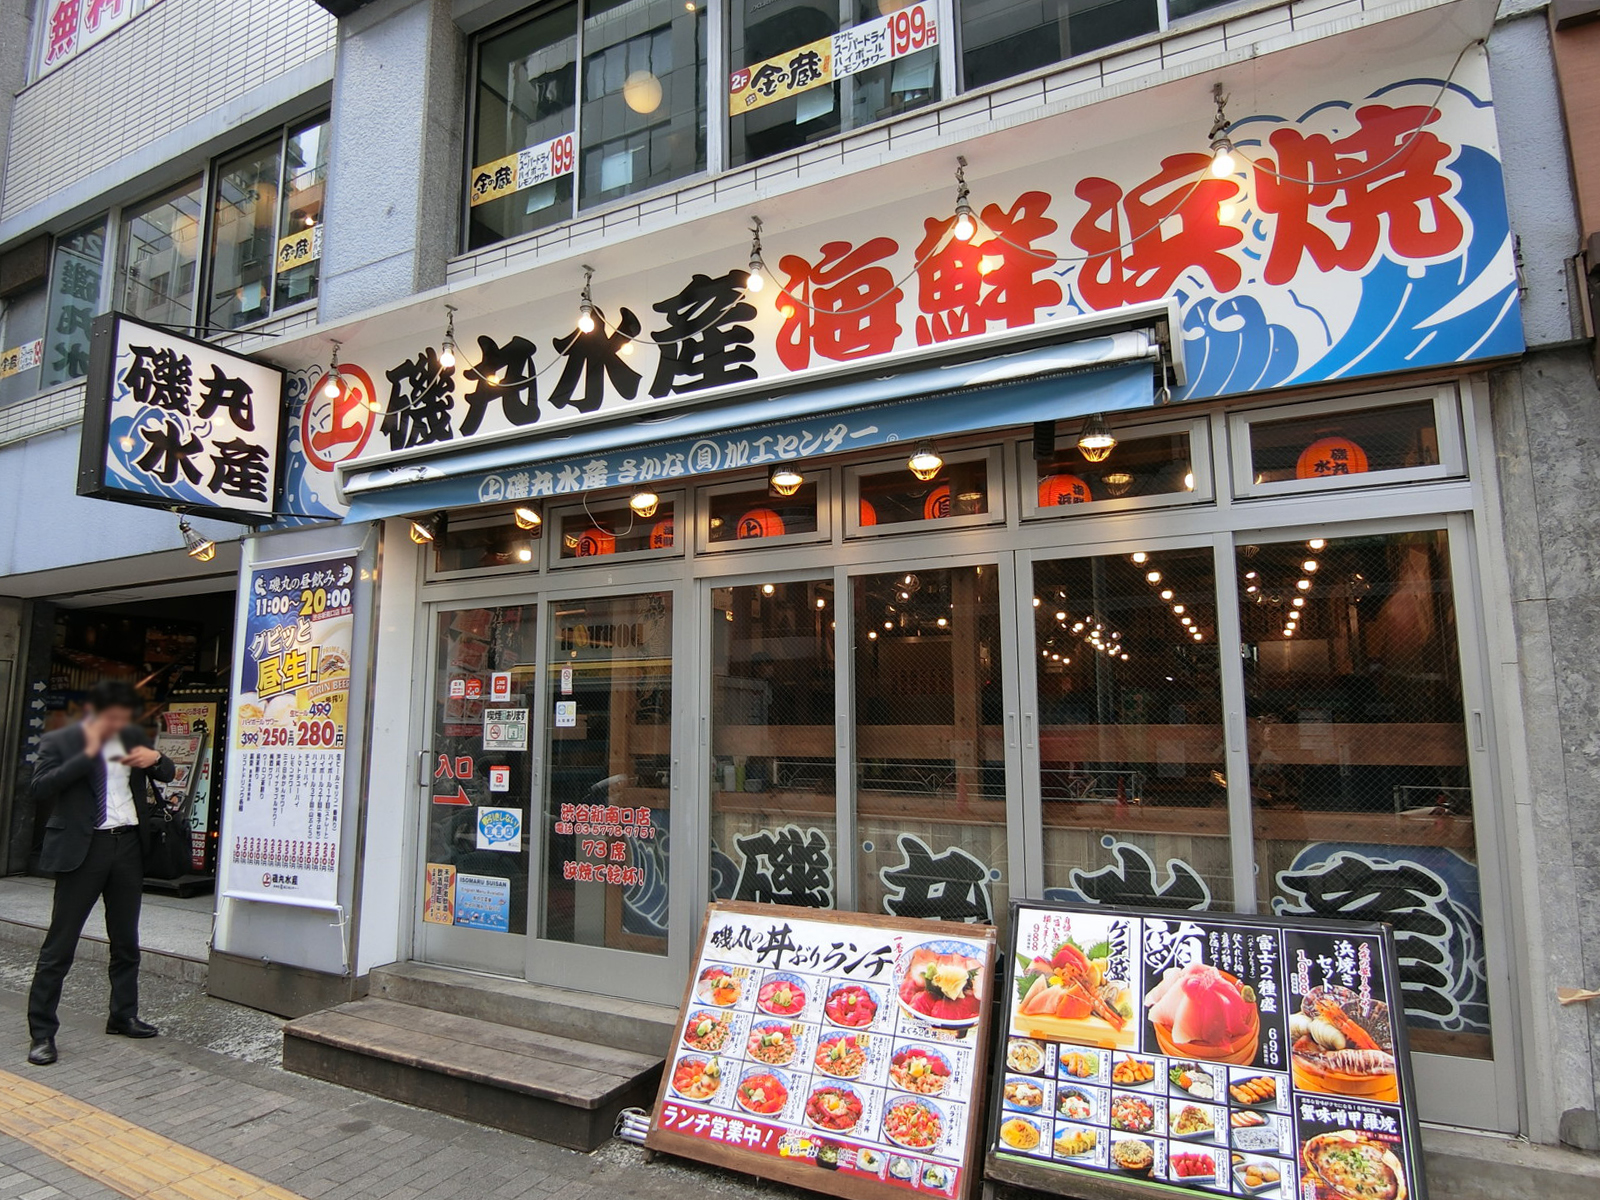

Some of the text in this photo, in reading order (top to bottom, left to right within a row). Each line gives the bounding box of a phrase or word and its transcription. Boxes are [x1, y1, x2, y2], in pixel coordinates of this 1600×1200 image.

[834, 31, 854, 45] アサヒ
[834, 27, 888, 56] スーパードライ
[887, 5, 937, 57] 199 円
[834, 41, 884, 67] ハイボール
[834, 54, 887, 77] レモンサワー
[731, 74, 748, 91] 2F
[751, 50, 822, 97] 金の蔵
[519, 151, 551, 170] スーパードライ
[550, 135, 573, 177] 199
[474, 165, 512, 194] 金の蔵
[518, 163, 548, 179] ハイボール
[518, 173, 549, 189] レモンサワー
[382, 104, 1464, 450] 磯丸水産 海鮮浜焼
[123, 344, 255, 432] 磯丸
[135, 419, 269, 502] 水産
[506, 459, 608, 499] 磯丸水産
[268, 570, 335, 593] 磯丸の昼飲み
[248, 616, 312, 660] グビッと
[262, 727, 288, 746] 250
[296, 720, 335, 746] 280
[435, 754, 473, 779] 入口
[561, 803, 651, 826] 渋谷新南口店
[582, 839, 607, 857] 73
[460, 877, 484, 885] ISOMARU
[563, 861, 644, 886] 浜焼で乾杯!
[711, 923, 894, 978] 磯丸の丼ぶりランチ
[1031, 923, 1040, 951] 988
[1316, 955, 1333, 993] セット
[1334, 940, 1356, 987] 浜焼き
[1268, 1028, 1278, 1064] 699
[664, 1105, 773, 1148] ランチ営業中!
